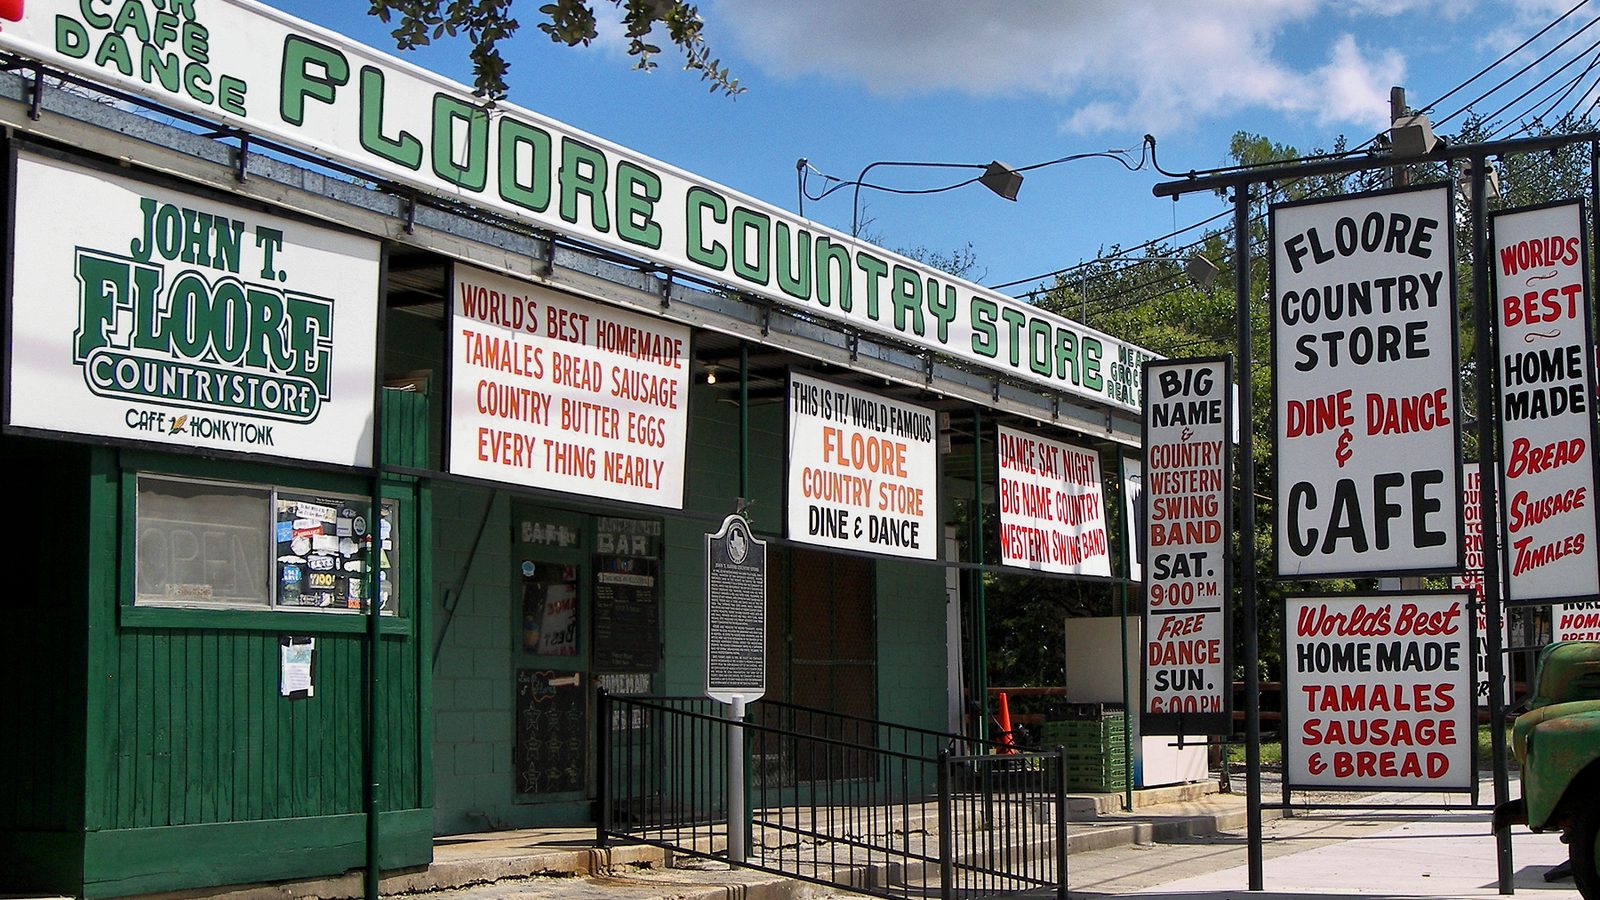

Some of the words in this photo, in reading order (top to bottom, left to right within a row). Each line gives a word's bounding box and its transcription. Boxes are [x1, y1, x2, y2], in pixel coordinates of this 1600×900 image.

[79, 0, 209, 63] CAFE
[56, 14, 247, 117] DANCE
[280, 34, 662, 250] FLOORE
[686, 186, 957, 344] COUNTRY
[970, 296, 1103, 392] STORE
[131, 197, 245, 275] JOHN
[256, 225, 286, 282] T.
[1284, 211, 1438, 274] FLOORE
[1500, 235, 1580, 276] WORLDS
[1281, 270, 1443, 326] COUNTRY
[1503, 283, 1582, 328] BEST
[74, 246, 334, 400] FLOORE
[460, 282, 538, 333] WORLD'S
[547, 305, 589, 346] BEST
[596, 319, 682, 369] HOMEMADE
[1294, 320, 1430, 372] STORE
[1504, 344, 1583, 388] HOME
[462, 329, 544, 379] TAMALES
[552, 351, 601, 393] BREAD
[611, 366, 678, 410] SAUSAGE
[1159, 368, 1213, 399] BIG
[477, 379, 551, 427] COUNTRY
[561, 398, 620, 440] BUTTER
[628, 412, 666, 448] EGGS
[792, 381, 818, 417] THIS
[820, 388, 832, 421] IS
[834, 392, 849, 425] IT!
[851, 397, 887, 433] WORLD
[890, 406, 931, 443] FAMOUS
[1107, 379, 1136, 406] REAL
[1152, 400, 1222, 428] NAME
[1286, 389, 1354, 438] DINE
[1366, 387, 1450, 436] DANCE
[1504, 383, 1586, 422] MADE
[125, 409, 165, 433] CAFE
[190, 413, 274, 446] HONKYTONK
[1180, 426, 1194, 442] &
[1335, 428, 1354, 468] &
[478, 427, 535, 469] EVERY
[544, 439, 595, 479] THING
[604, 450, 664, 490] NEARLY
[823, 426, 908, 478] FLOORE
[1000, 432, 1036, 475] DANCE
[1062, 449, 1095, 488] NIGHT
[1150, 440, 1223, 470] COUNTRY
[1506, 437, 1586, 479] BREAD
[802, 467, 872, 508] COUNTRY
[878, 482, 924, 517] STORE
[1001, 478, 1020, 515] BIG
[1022, 482, 1053, 521] NAME
[1055, 490, 1099, 527] COUNTRY
[1150, 469, 1222, 495] WESTERN
[808, 504, 849, 540] DINE
[853, 516, 863, 539] &
[869, 514, 919, 549] DANCE
[1151, 494, 1219, 521] SWING
[1287, 469, 1447, 557] CAFE
[1509, 486, 1587, 534] SAUSAGE
[597, 532, 646, 555] BAR
[1000, 521, 1050, 564] WESTERN
[1052, 529, 1082, 566] SWING
[1082, 528, 1106, 559] BAND
[1151, 520, 1221, 547] BAND
[1512, 533, 1585, 577] TAMALES
[1153, 552, 1214, 580] SAT.
[1150, 581, 1194, 607] 9:00
[1197, 581, 1221, 597] P.M.
[1157, 614, 1205, 641] FREE
[1297, 603, 1392, 637] World's
[1394, 602, 1461, 637] Best
[1560, 613, 1600, 630] HOM
[1149, 639, 1221, 666] DANCE
[1154, 669, 1214, 692] SUN.
[1302, 683, 1455, 713] TAMALES
[1302, 718, 1457, 746] SAUSAGE
[1307, 752, 1328, 775] &
[1333, 751, 1449, 778] BREAD
